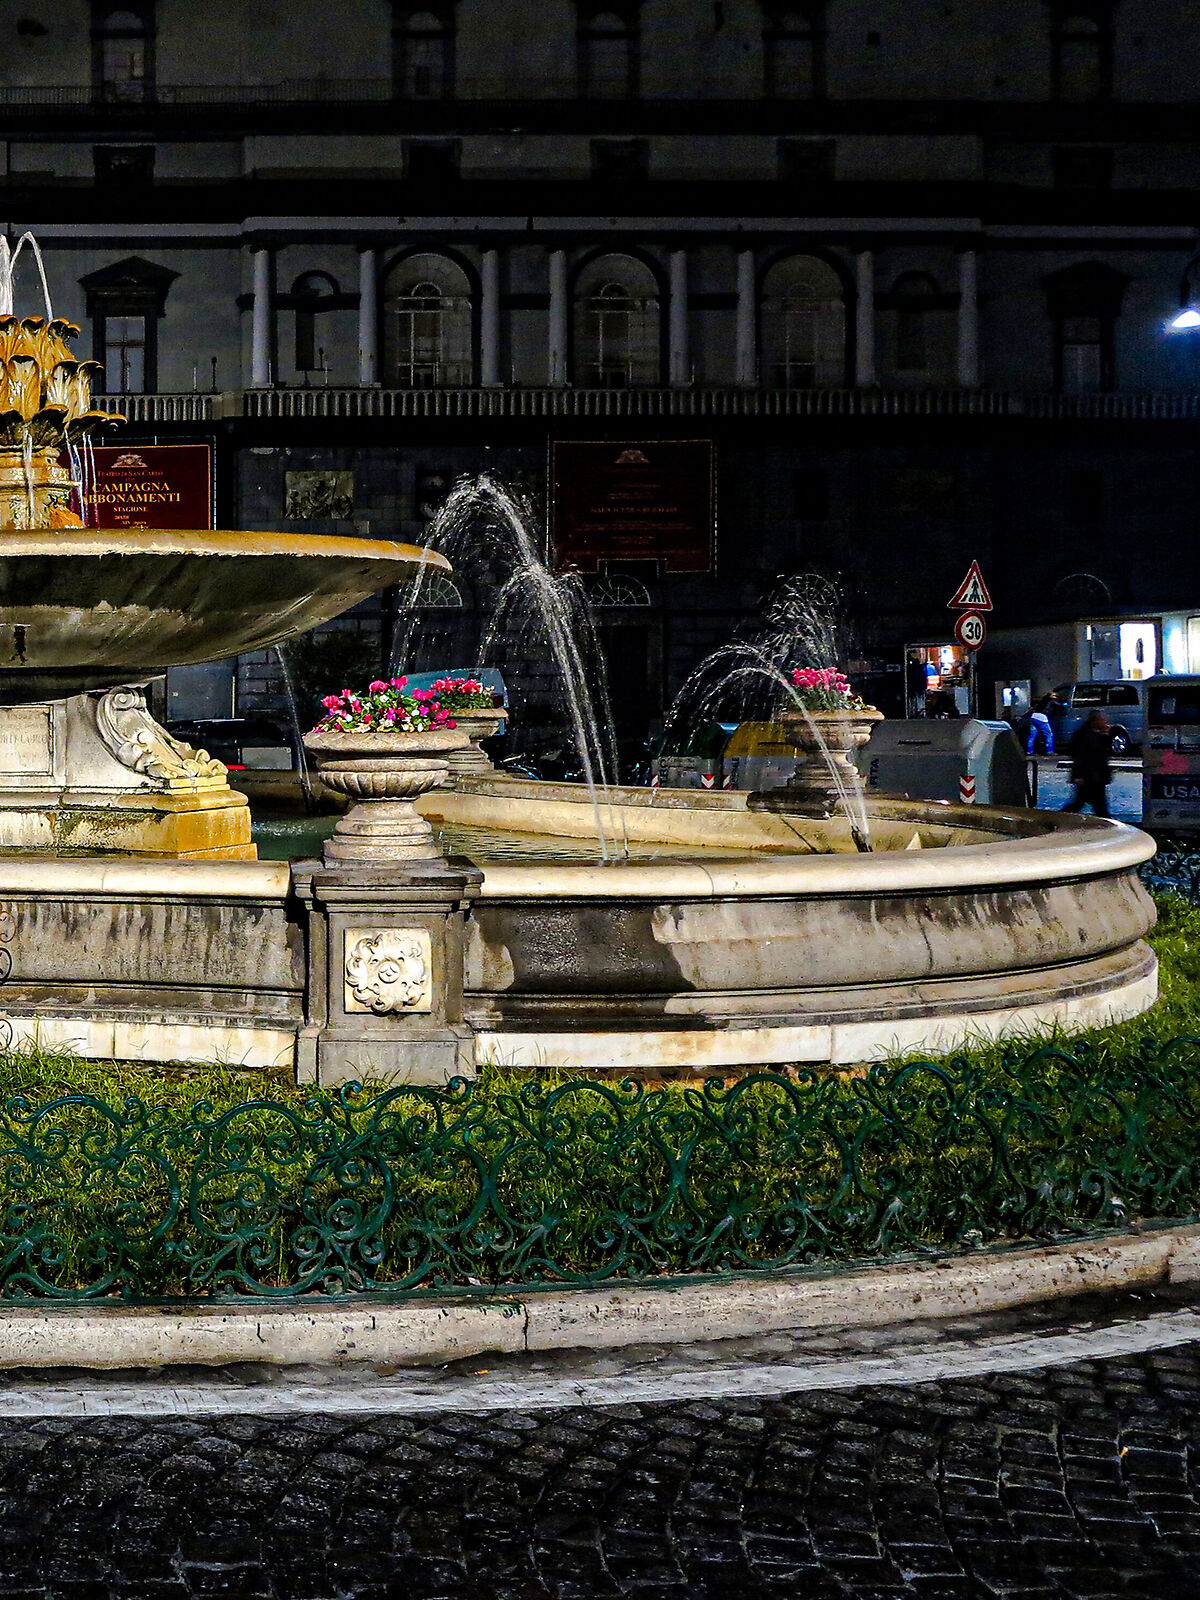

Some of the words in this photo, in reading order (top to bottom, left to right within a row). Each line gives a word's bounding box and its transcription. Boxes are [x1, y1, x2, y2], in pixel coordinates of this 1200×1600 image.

[92, 482, 170, 493] CAMPAGNA
[84, 493, 181, 503] BBONAMENTI
[965, 622, 981, 640] 30
